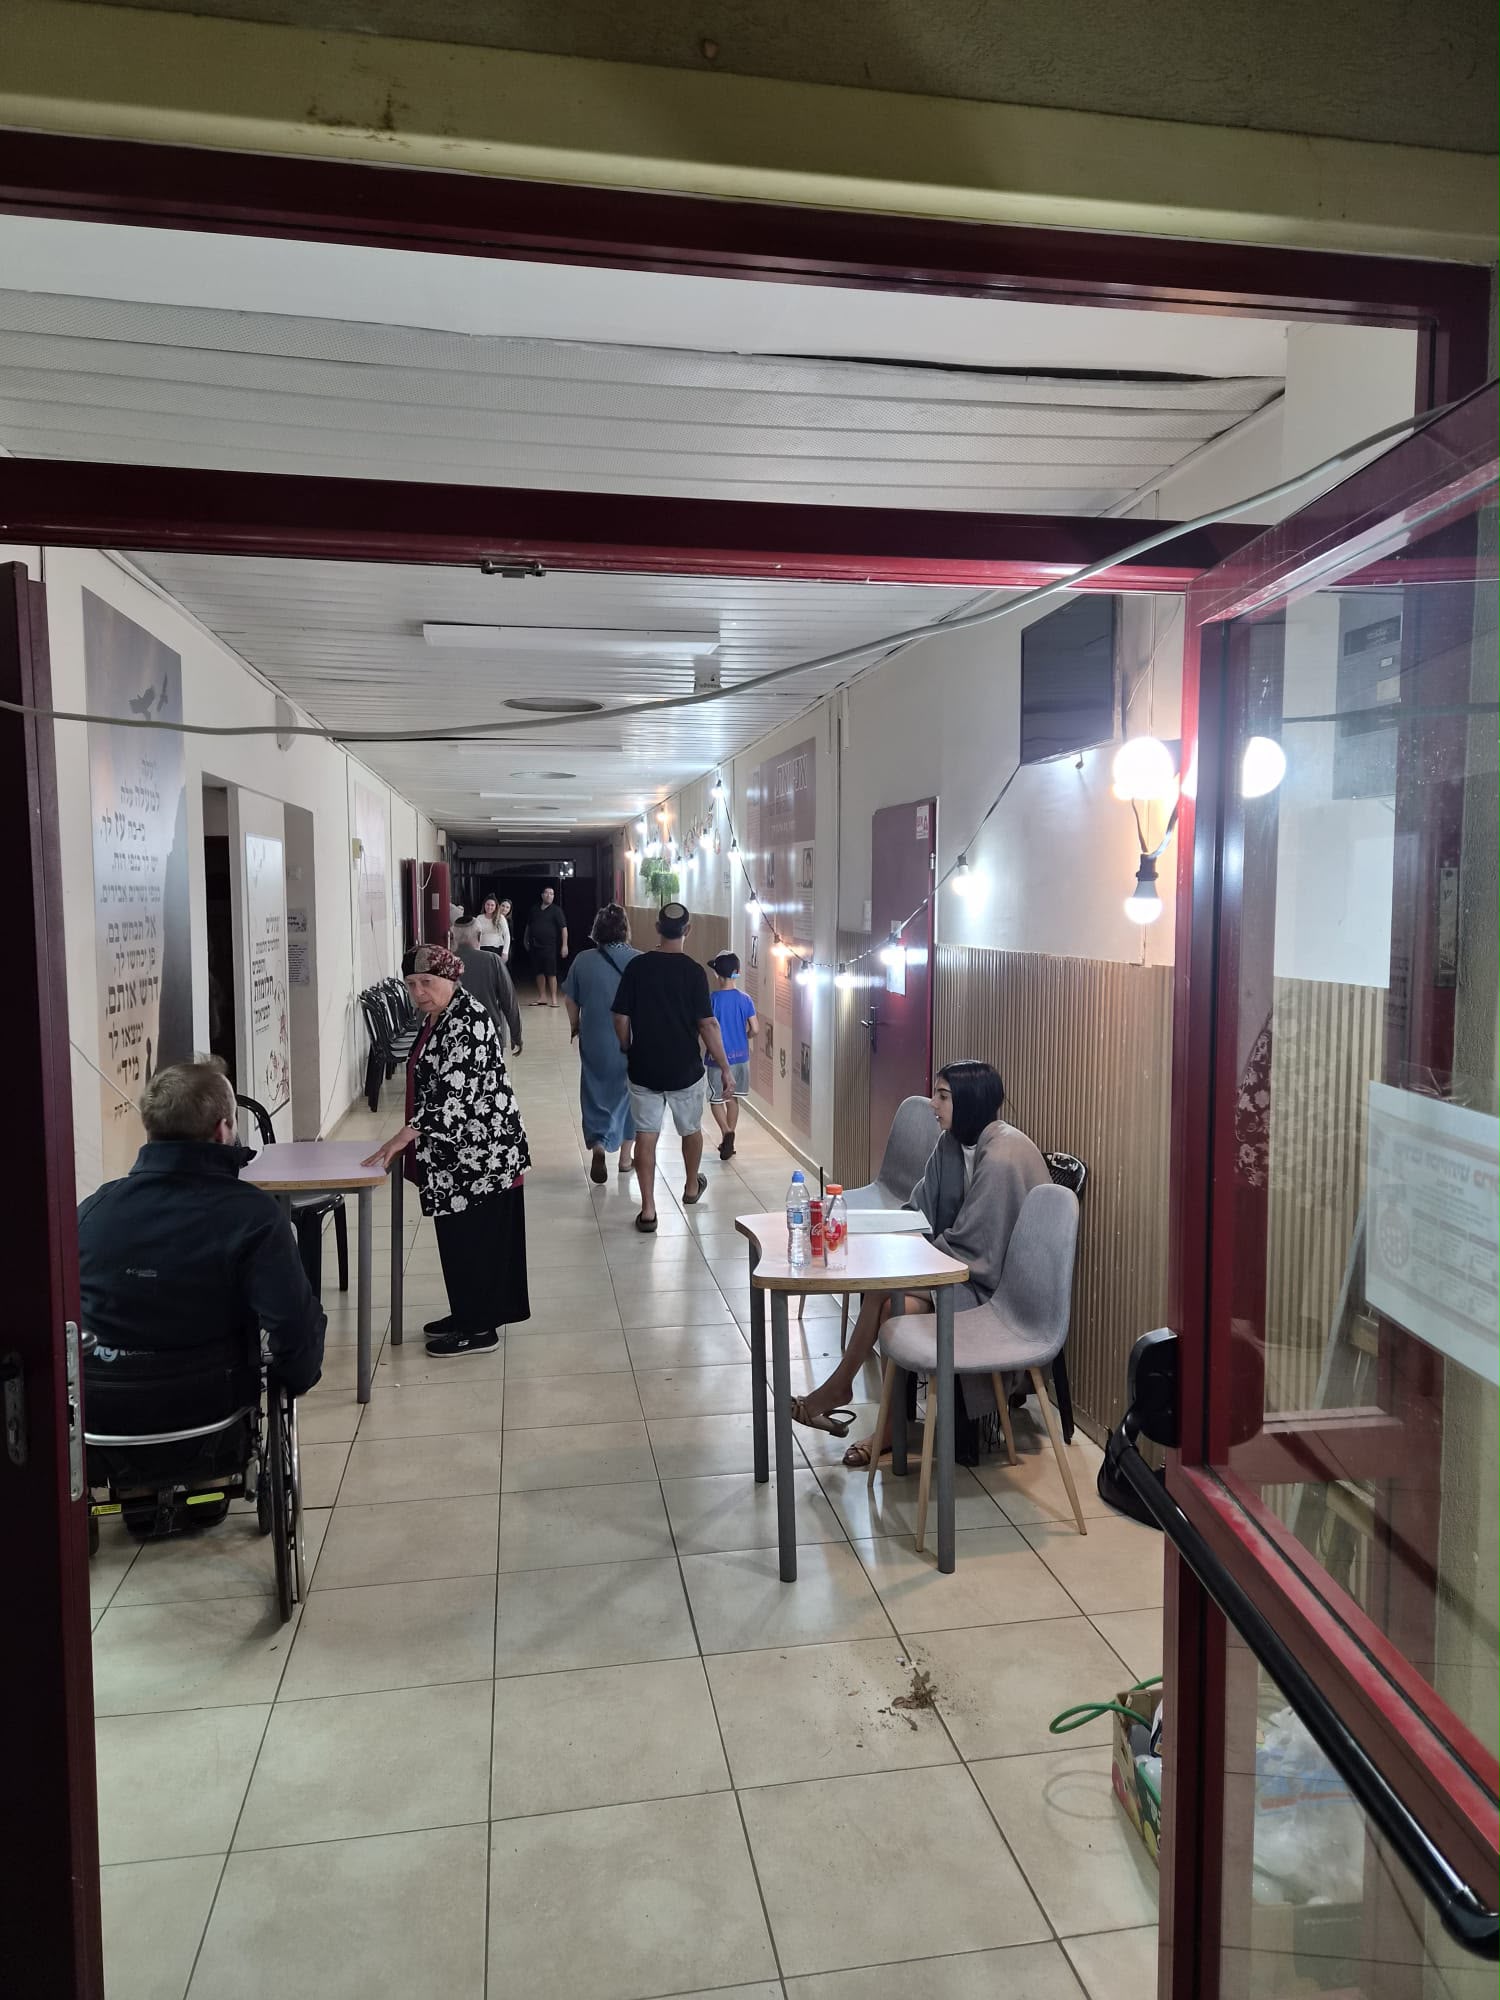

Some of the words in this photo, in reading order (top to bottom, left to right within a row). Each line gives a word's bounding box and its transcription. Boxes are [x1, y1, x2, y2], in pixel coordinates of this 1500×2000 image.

[144, 905, 157, 939] אל
[139, 976, 159, 1006] דרש
[108, 1020, 119, 1060] לך
